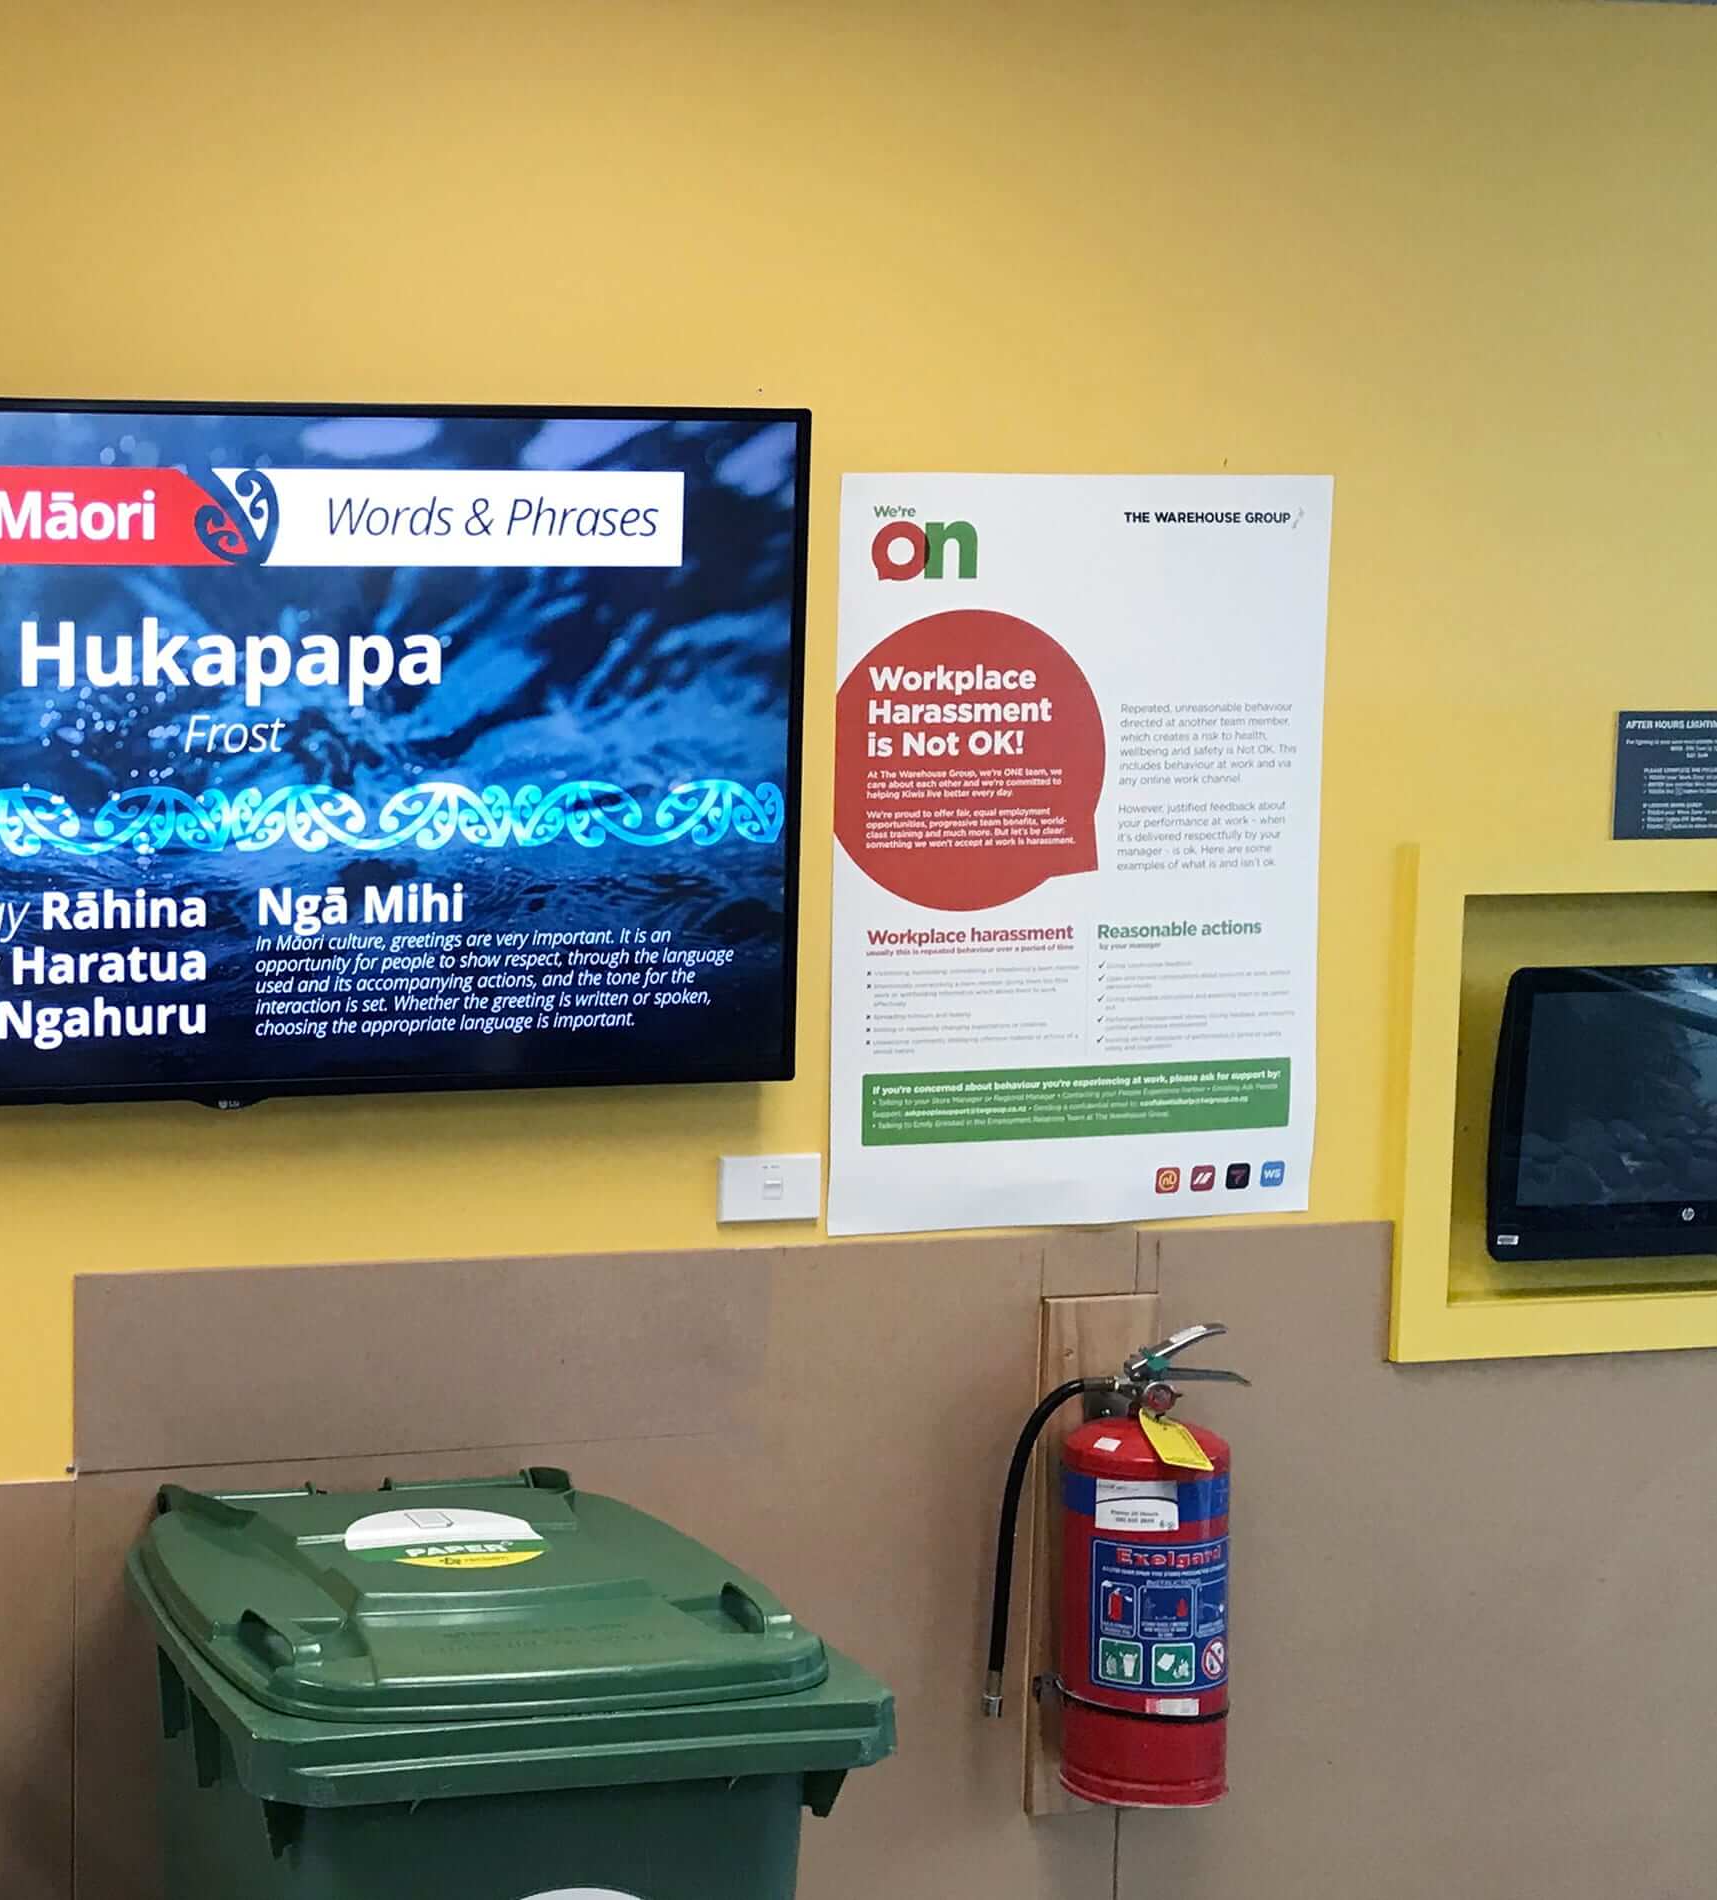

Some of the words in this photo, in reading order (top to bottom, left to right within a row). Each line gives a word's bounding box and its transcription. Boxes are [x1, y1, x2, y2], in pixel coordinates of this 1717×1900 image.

[327, 495, 454, 537] Words
[463, 496, 495, 537] &
[505, 496, 660, 537] Phrases
[873, 504, 917, 520] We're
[1123, 511, 1150, 523] THE
[1153, 511, 1241, 523] WAREHOUSE
[1244, 511, 1291, 523] GROUP
[871, 519, 979, 582] on
[19, 618, 442, 707] Hukapapa
[868, 664, 1037, 697] Workplace
[868, 697, 1053, 725] Harassment
[1174, 703, 1242, 713] unreasonable
[1243, 702, 1292, 712] behaviour
[182, 713, 288, 753] Frost
[867, 731, 893, 757] is
[901, 731, 960, 756] Not
[967, 729, 1024, 755] OK!
[866, 770, 878, 778] At
[880, 769, 897, 778] The
[898, 769, 947, 778] Warehouse
[1003, 767, 1023, 776] ONE
[1048, 769, 1062, 777] we
[40, 887, 207, 930] Rāhina
[257, 885, 348, 934] Ngā
[362, 881, 464, 924] Mihi
[255, 935, 272, 951] In
[275, 932, 325, 951] Māori
[327, 932, 386, 951] culture,
[388, 931, 462, 952] greetings
[465, 933, 492, 947] are
[495, 932, 529, 950] very
[531, 929, 614, 948] important.
[619, 927, 631, 944] It
[633, 927, 647, 943] is
[649, 929, 671, 943] an
[866, 928, 966, 946] Workplace
[970, 925, 1073, 942] harassment
[1097, 921, 1197, 938] Reasonable
[1200, 919, 1262, 936] actions
[10, 945, 207, 985] Haratua
[254, 955, 352, 976] opportunity
[350, 952, 379, 975] for
[379, 952, 435, 973] people
[438, 954, 456, 968] to
[458, 951, 502, 968] show
[503, 951, 562, 970] respect,
[567, 948, 630, 972] through
[633, 947, 659, 965] the
[661, 947, 734, 969] language
[254, 975, 294, 994] used
[296, 975, 330, 992] and
[332, 975, 354, 992] its
[355, 973, 474, 994] accompanying
[476, 972, 537, 989] actions,
[541, 969, 574, 987] and
[577, 969, 602, 985] the
[605, 971, 641, 985] tone
[641, 967, 668, 988] for
[670, 967, 696, 984] the
[254, 997, 341, 1014] interaction
[344, 995, 358, 1012] is
[361, 997, 388, 1012] set.
[393, 994, 460, 1011] Whether
[462, 992, 489, 1010] the
[490, 992, 556, 1013] greeting
[558, 991, 571, 1007] is
[574, 990, 629, 1006] written
[631, 991, 651, 1005] or
[652, 988, 711, 1008] spoken,
[254, 1018, 328, 1038] choosing
[331, 1017, 357, 1034] the
[360, 1015, 456, 1036] appropriate
[458, 1014, 533, 1034] language
[535, 1012, 549, 1028] is
[552, 1012, 635, 1031] important.
[872, 1085, 880, 1095] If
[881, 1085, 911, 1096] you're
[913, 1082, 963, 1093] concerned
[964, 1081, 992, 1091] about
[993, 1080, 1040, 1090] behaviour
[1041, 1079, 1071, 1090] you're
[1072, 1076, 1131, 1087] experiencing
[1131, 1075, 1141, 1084] at
[1142, 1074, 1168, 1084] work,
[1168, 1073, 1198, 1084] please
[1199, 1071, 1214, 1081] ask
[1216, 1071, 1229, 1080] for
[1230, 1070, 1265, 1080] support
